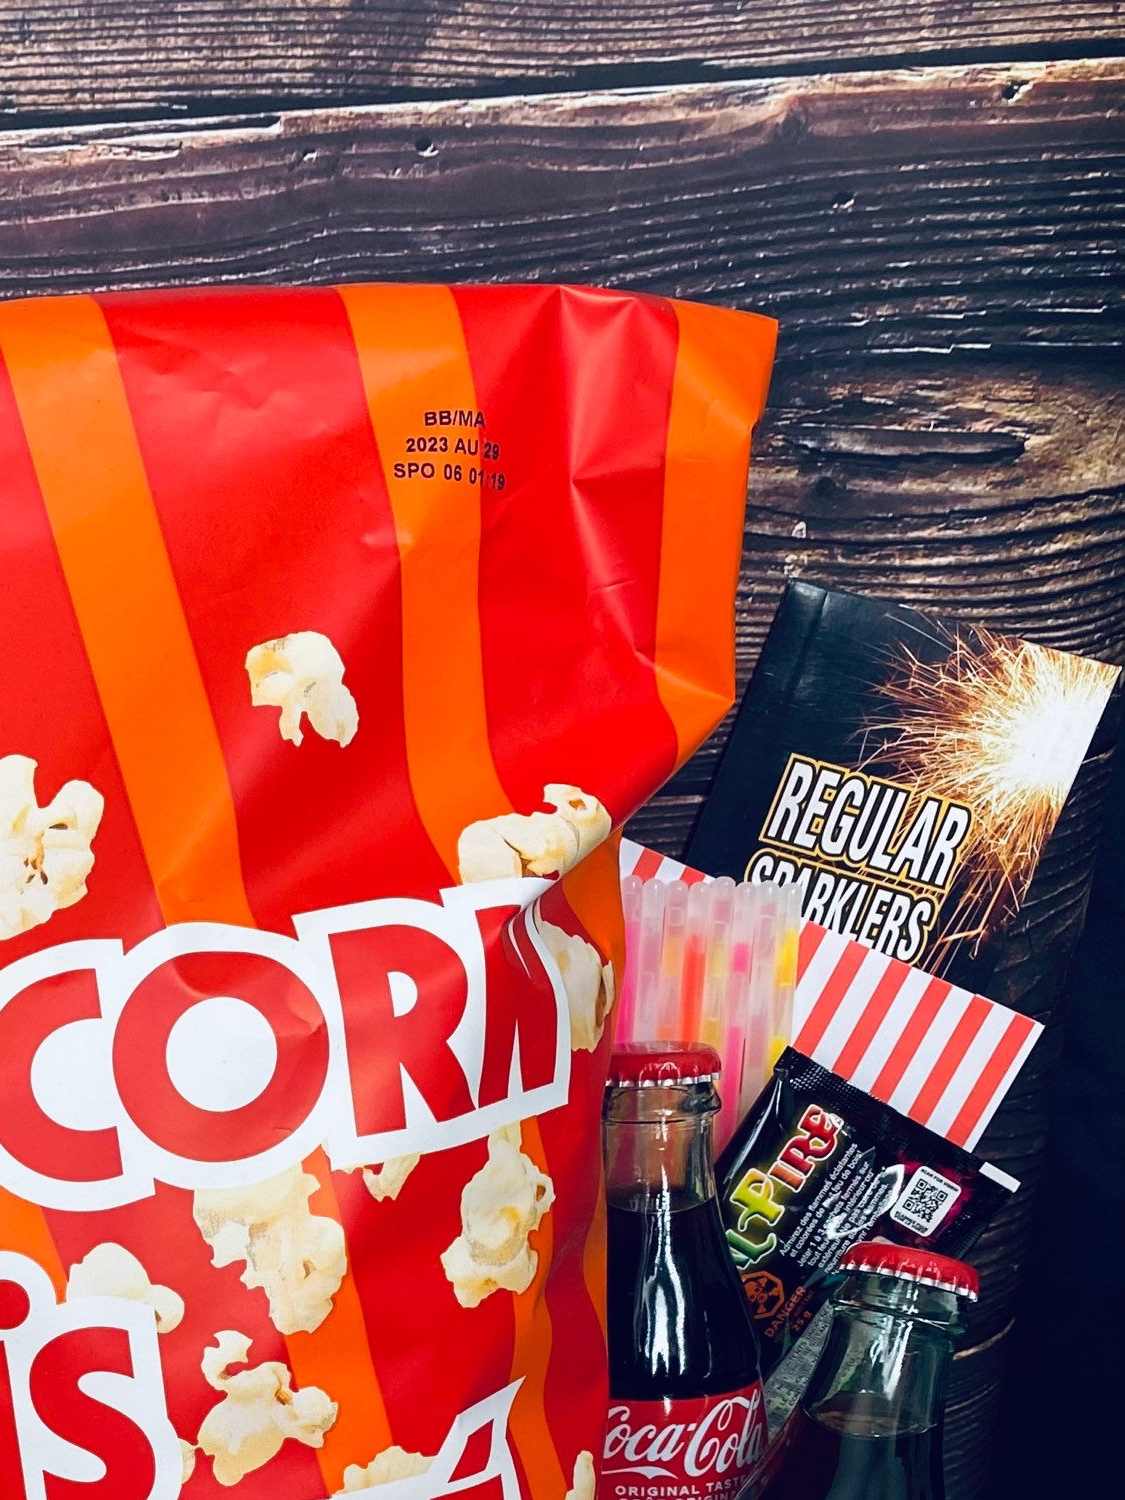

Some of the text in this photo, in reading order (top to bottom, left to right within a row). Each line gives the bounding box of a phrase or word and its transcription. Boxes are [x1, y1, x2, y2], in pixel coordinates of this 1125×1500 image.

[424, 410, 486, 428] BB/MA
[406, 436, 500, 460] 2023 AU 29
[393, 462, 435, 479] SPO
[443, 463, 462, 481] 06
[767, 760, 971, 887] REGULAR
[798, 1210, 812, 1226] des
[615, 1484, 700, 1498] ORIGINAL
